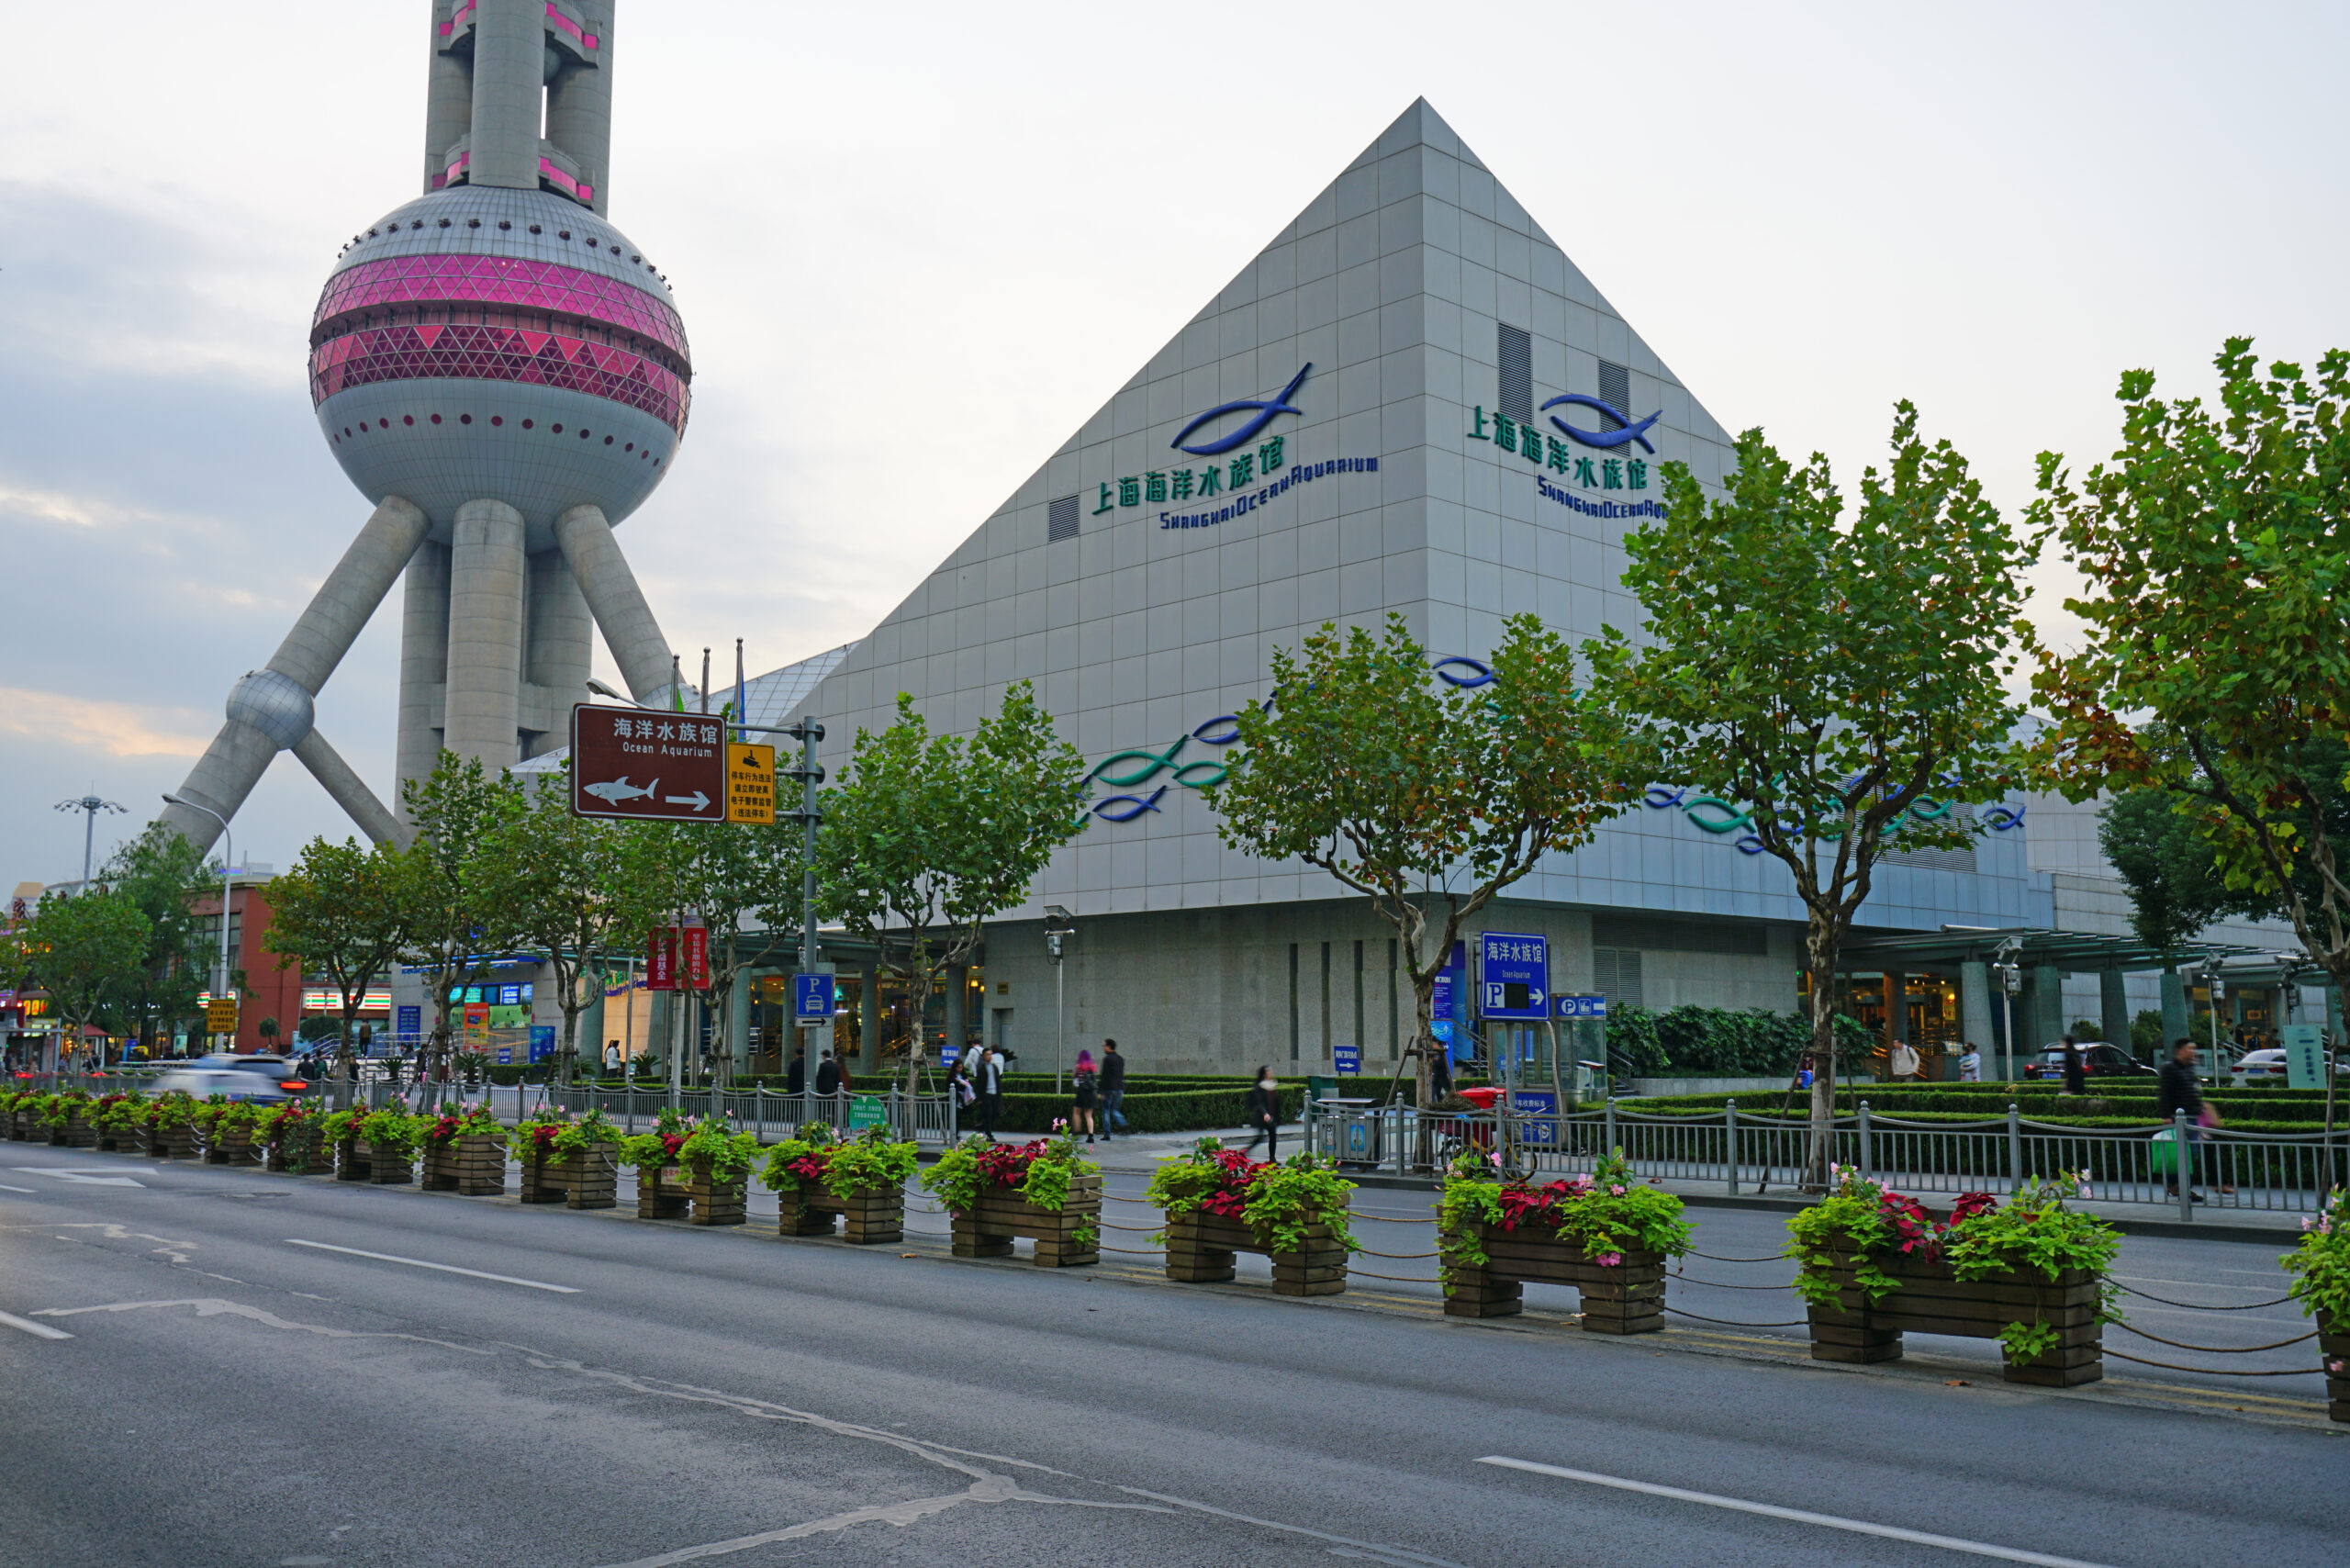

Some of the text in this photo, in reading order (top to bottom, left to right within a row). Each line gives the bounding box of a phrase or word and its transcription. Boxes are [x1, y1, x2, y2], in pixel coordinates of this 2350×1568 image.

[1468, 406, 1648, 489] 上海海洋水族馆
[1092, 435, 1284, 515] 上海海洋水族馆
[613, 717, 718, 745] 海洋水族馆
[623, 742, 712, 757] Ocean Aquarium
[732, 771, 771, 782] 停车行为违法
[1488, 941, 1542, 963] 海洋水族馆
[810, 978, 820, 992] P
[1489, 984, 1502, 1006] P
